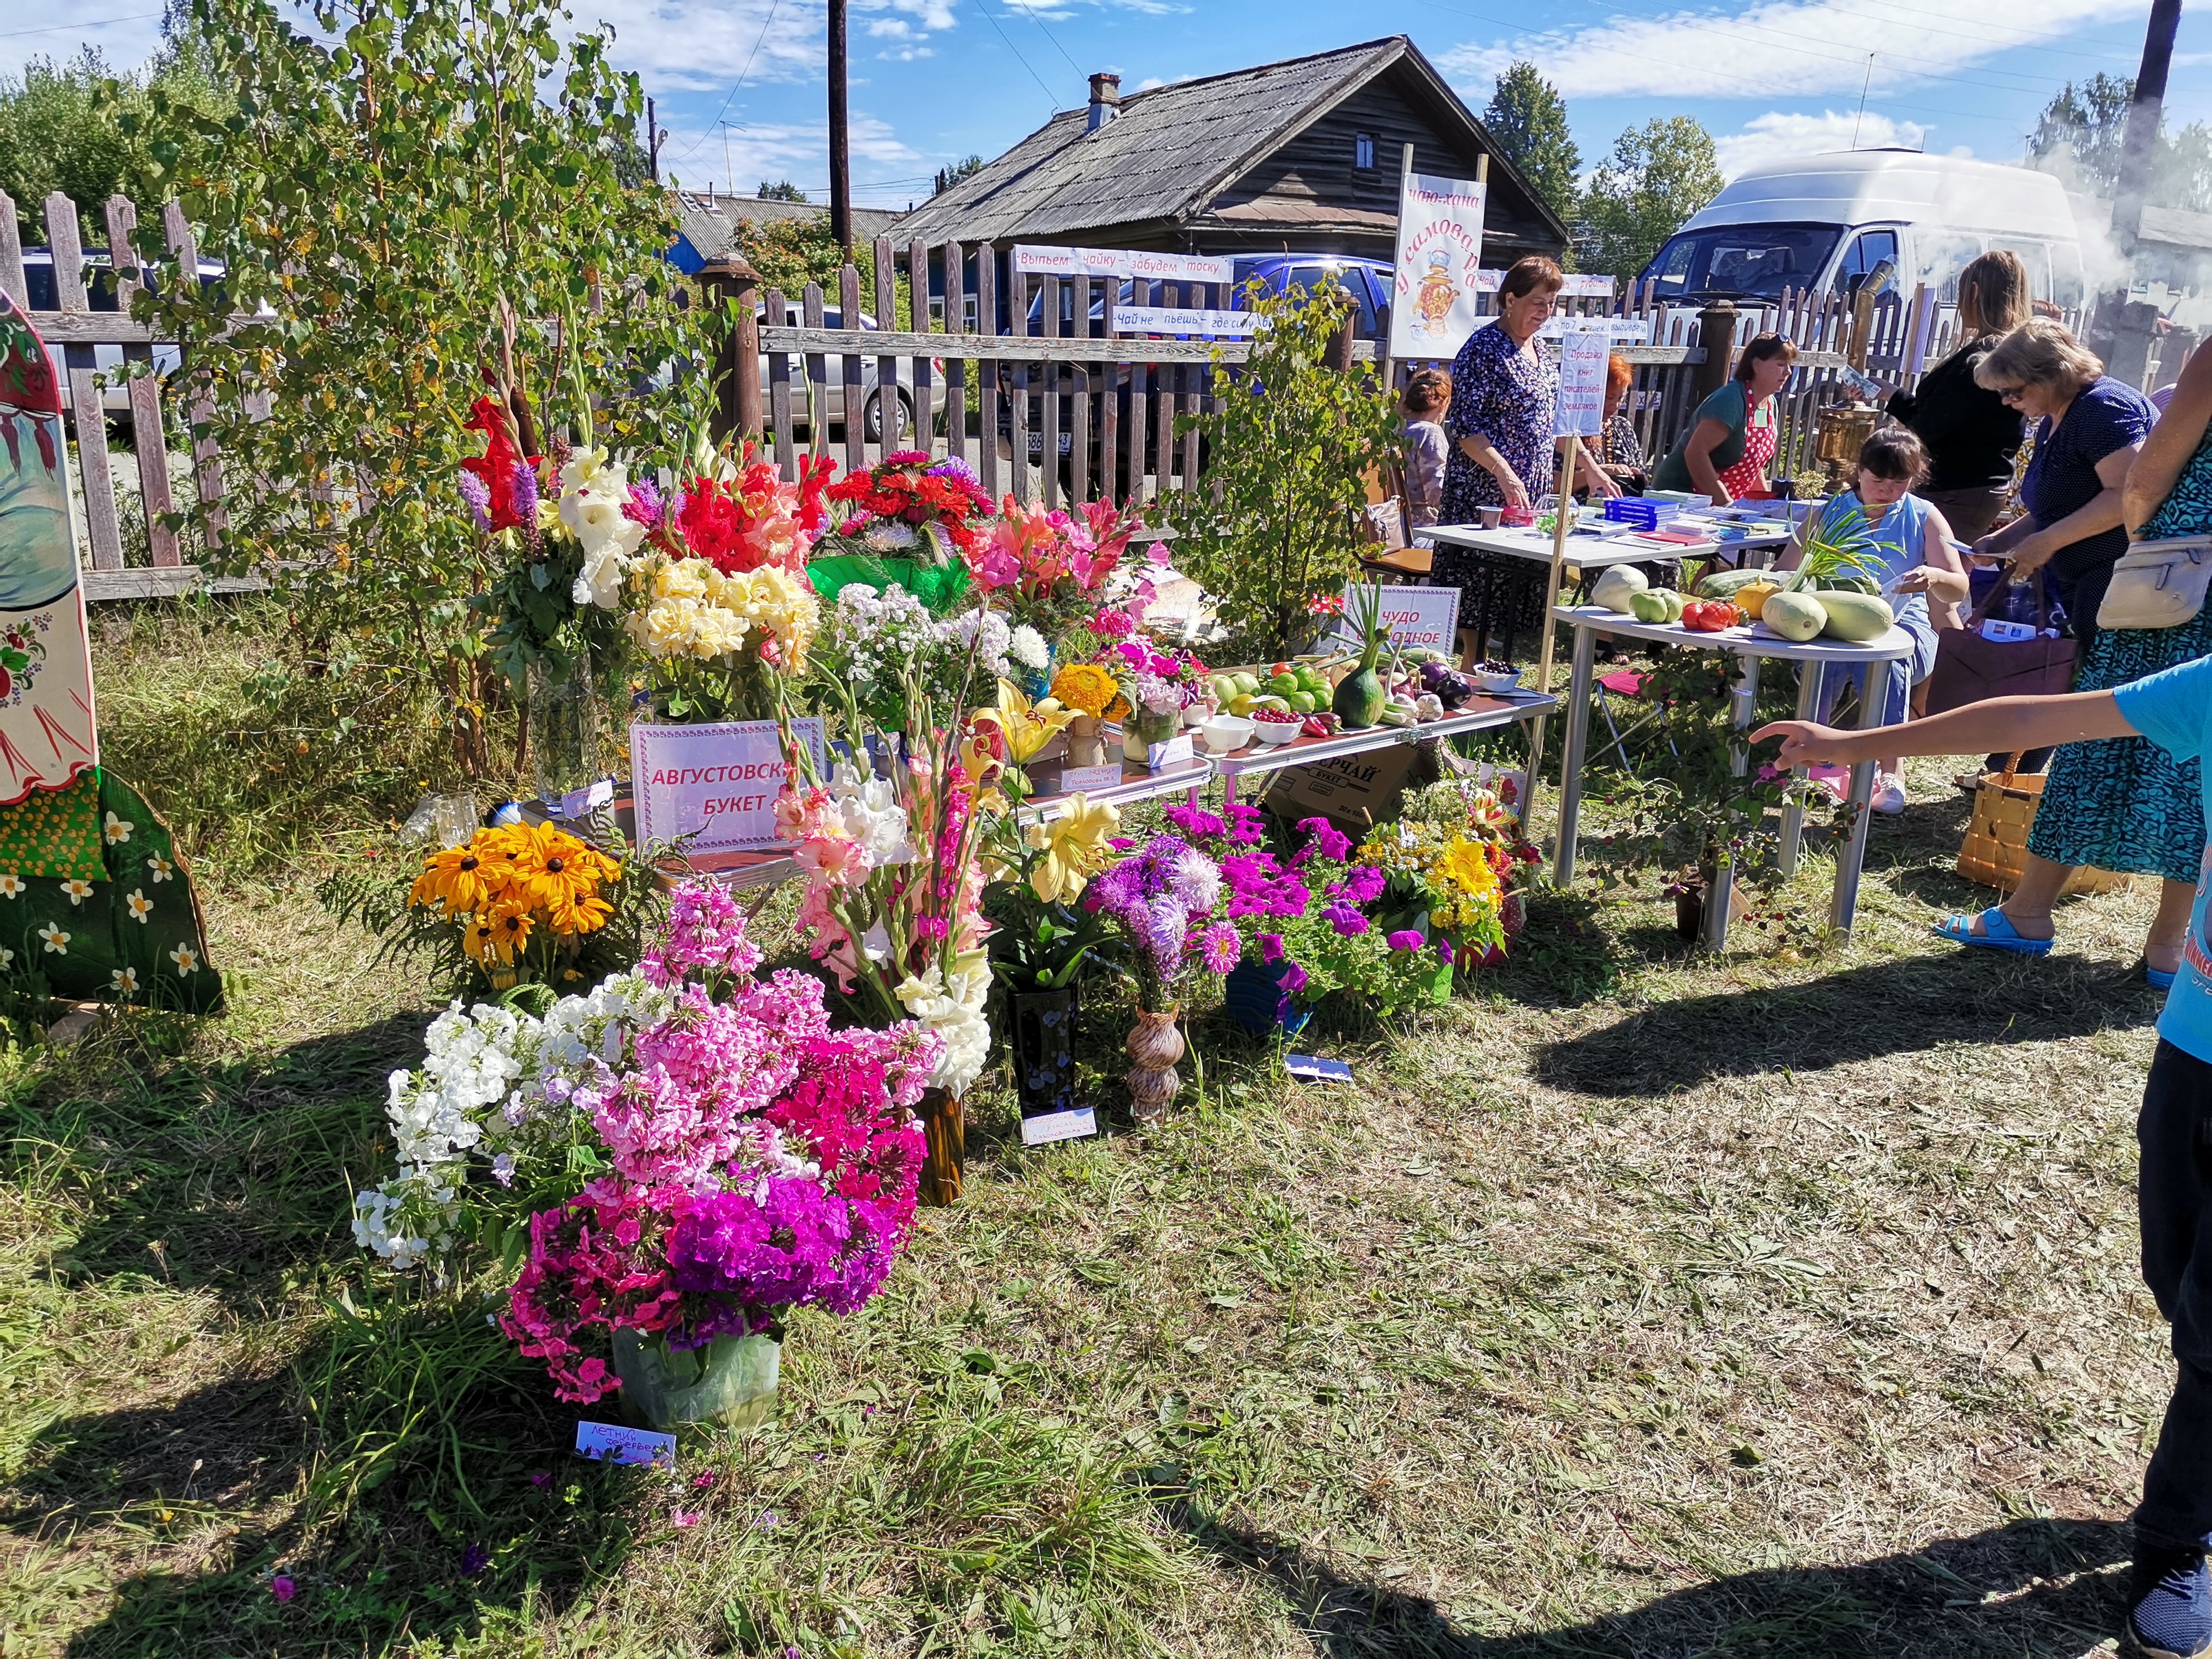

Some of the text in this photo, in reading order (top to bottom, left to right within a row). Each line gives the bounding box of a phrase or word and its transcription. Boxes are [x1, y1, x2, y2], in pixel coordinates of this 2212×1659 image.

[1405, 219, 1479, 289] самовара
[1021, 252, 1070, 266] Выпьем
[1083, 252, 1116, 268] чайку
[1131, 258, 1177, 273] забудем
[1187, 262, 1219, 275] тоску
[1580, 278, 1608, 290] рубить
[1118, 312, 1138, 325] Чай
[1141, 317, 1154, 325] не
[1164, 312, 1198, 325] пьёшь
[1212, 316, 1229, 328] где
[1582, 324, 1605, 332] шек
[1571, 349, 1603, 360] Продажа
[1383, 611, 1420, 625] ЧУДО
[1357, 630, 1441, 645] ООДНОЕ
[651, 762, 787, 785] АВГУСТОВСК
[1316, 771, 1342, 784] БУКЕТ
[703, 795, 768, 815] БУКЕТ
